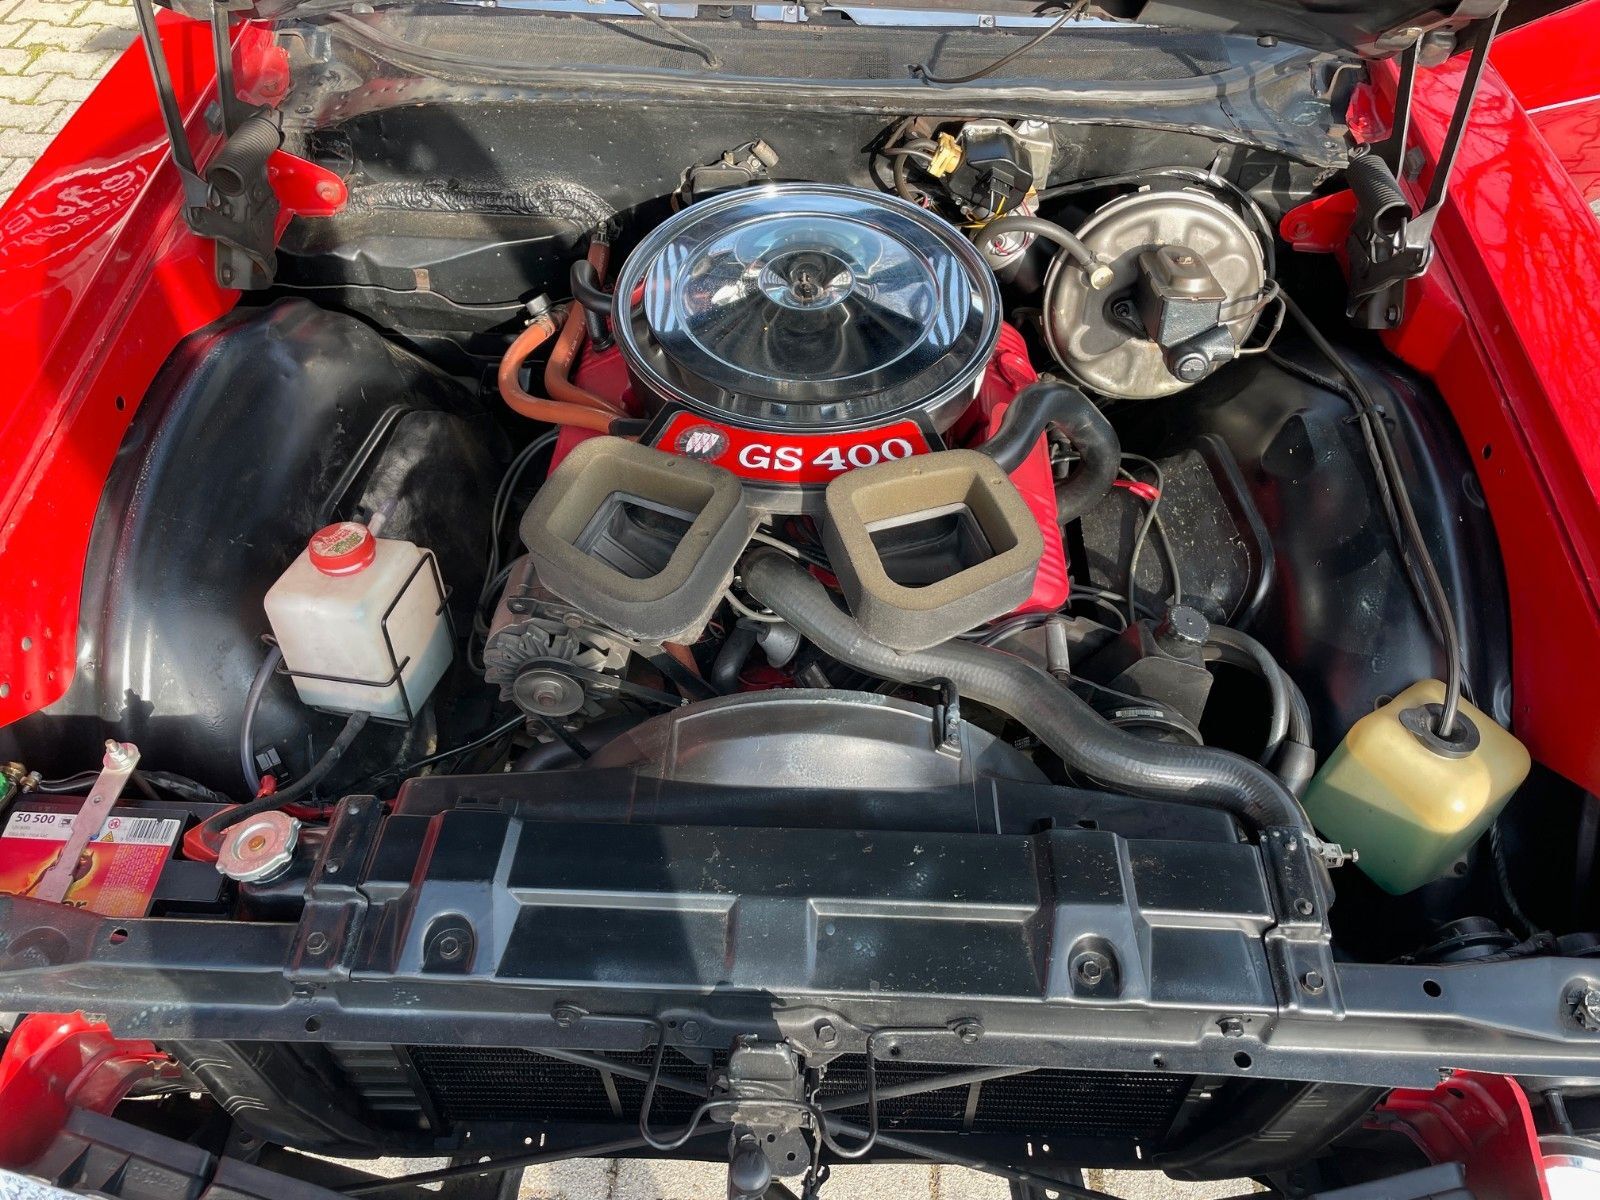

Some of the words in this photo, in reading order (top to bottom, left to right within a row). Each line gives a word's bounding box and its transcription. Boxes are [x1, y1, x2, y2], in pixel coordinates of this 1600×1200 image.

[738, 443, 804, 472] GS
[812, 438, 914, 471] 400
[15, 813, 31, 823] 50
[32, 814, 56, 824] 500
